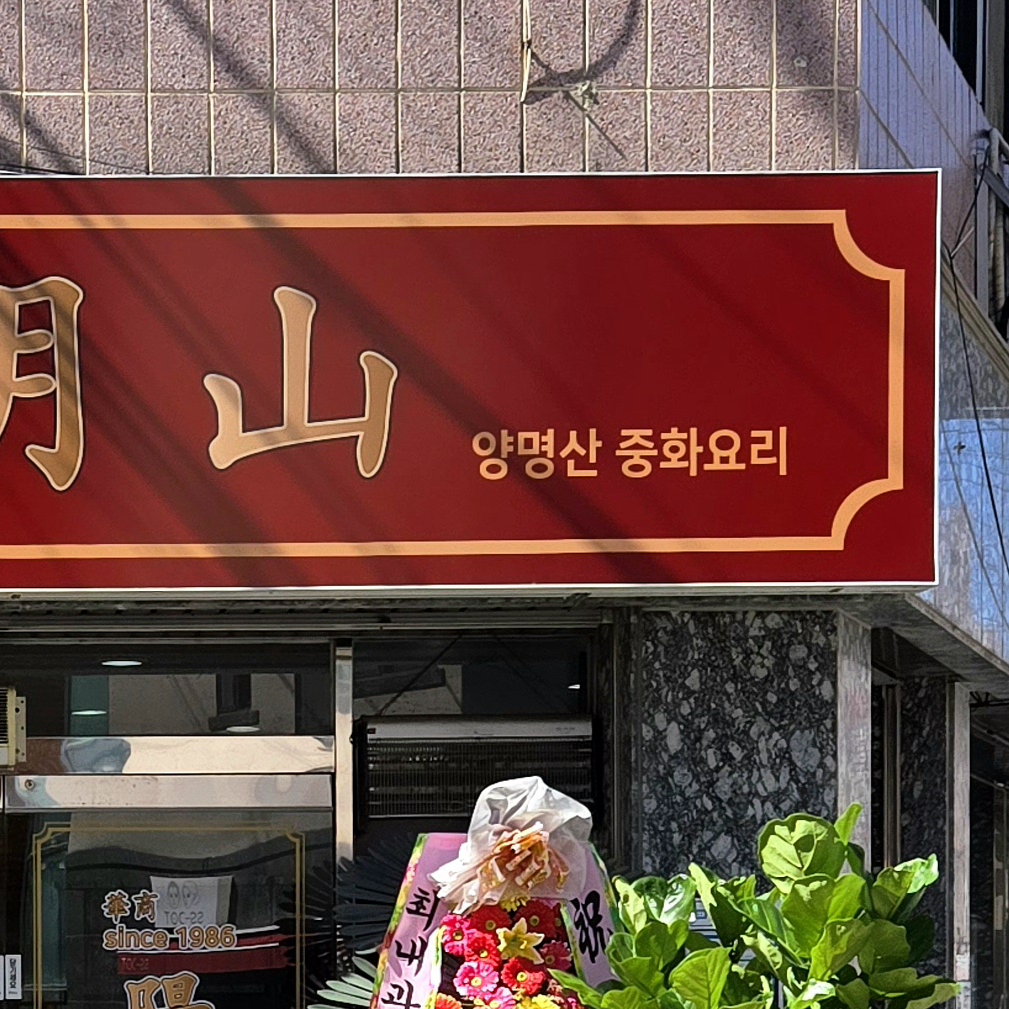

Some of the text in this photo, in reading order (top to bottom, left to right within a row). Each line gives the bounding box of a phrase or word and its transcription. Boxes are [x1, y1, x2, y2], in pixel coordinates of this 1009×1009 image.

[472, 426, 790, 481] 양명산 중화요리
[103, 891, 159, 922] 華商
[103, 924, 237, 949] since 1986
